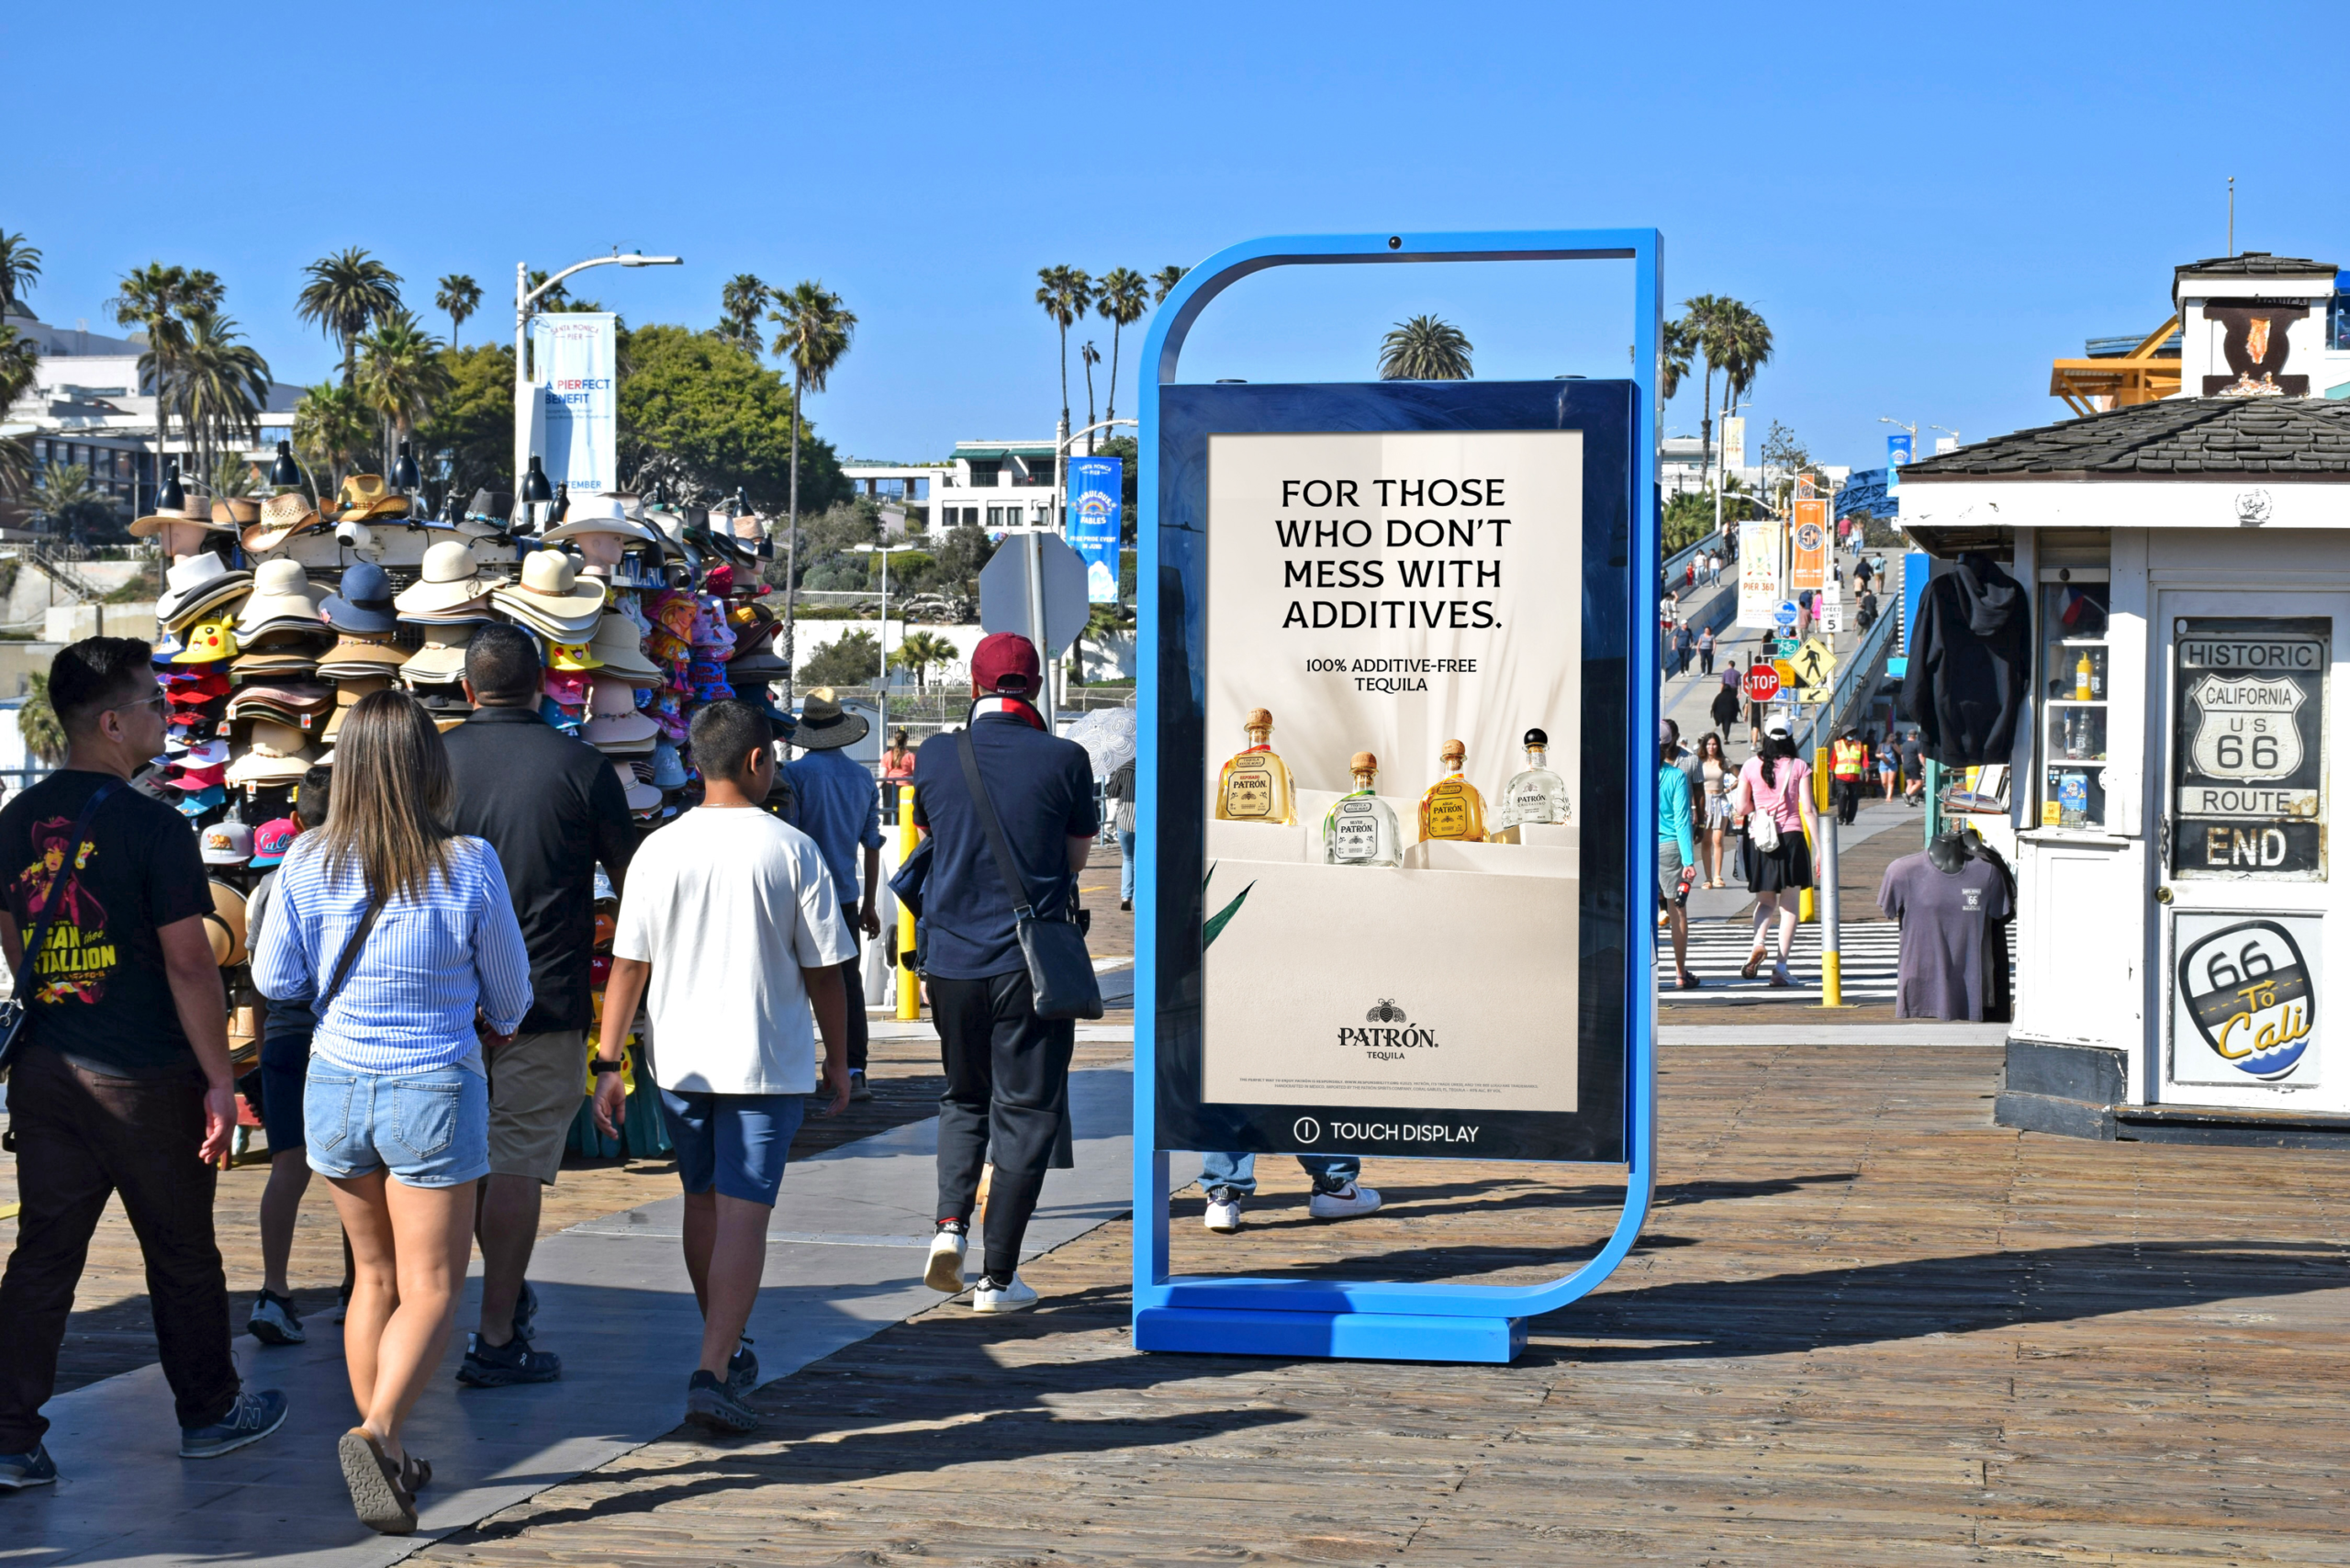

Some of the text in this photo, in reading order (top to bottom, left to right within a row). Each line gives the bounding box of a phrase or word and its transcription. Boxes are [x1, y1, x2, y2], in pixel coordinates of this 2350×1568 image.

[551, 324, 599, 335] SANTA MONICA
[545, 379, 610, 390] A PIERFECT
[545, 394, 589, 404] BENEFIT
[1093, 464, 1112, 472] MONICA
[550, 480, 601, 488] SETEMBER
[1282, 479, 1505, 507] FOR THOSE
[1078, 490, 1112, 506] FABULOUS
[1080, 516, 1106, 524] FABLES
[1275, 519, 1512, 547] WHO DON'T
[1284, 560, 1501, 588] MESS WITH
[1282, 600, 1502, 629] ADDITIVES.
[1828, 620, 1836, 630] 5
[2189, 644, 2312, 668] HISTORIC
[1305, 658, 1477, 673] 100% ADDITIVE-FREE
[1355, 678, 1428, 694] TEQUILA
[1744, 675, 1777, 689] STOP
[2206, 687, 2292, 707] CALIFORNIA
[2216, 735, 2278, 770] 66
[2203, 791, 2290, 812] ROUTE
[2207, 828, 2287, 867] END
[1969, 895, 1977, 904] 66
[2207, 940, 2275, 991] 66
[2237, 980, 2277, 1014] To
[2219, 1005, 2310, 1059] Cali
[1367, 1052, 1405, 1060] TEQUILA
[1331, 1122, 1479, 1143] TOUCH DISPLAY
